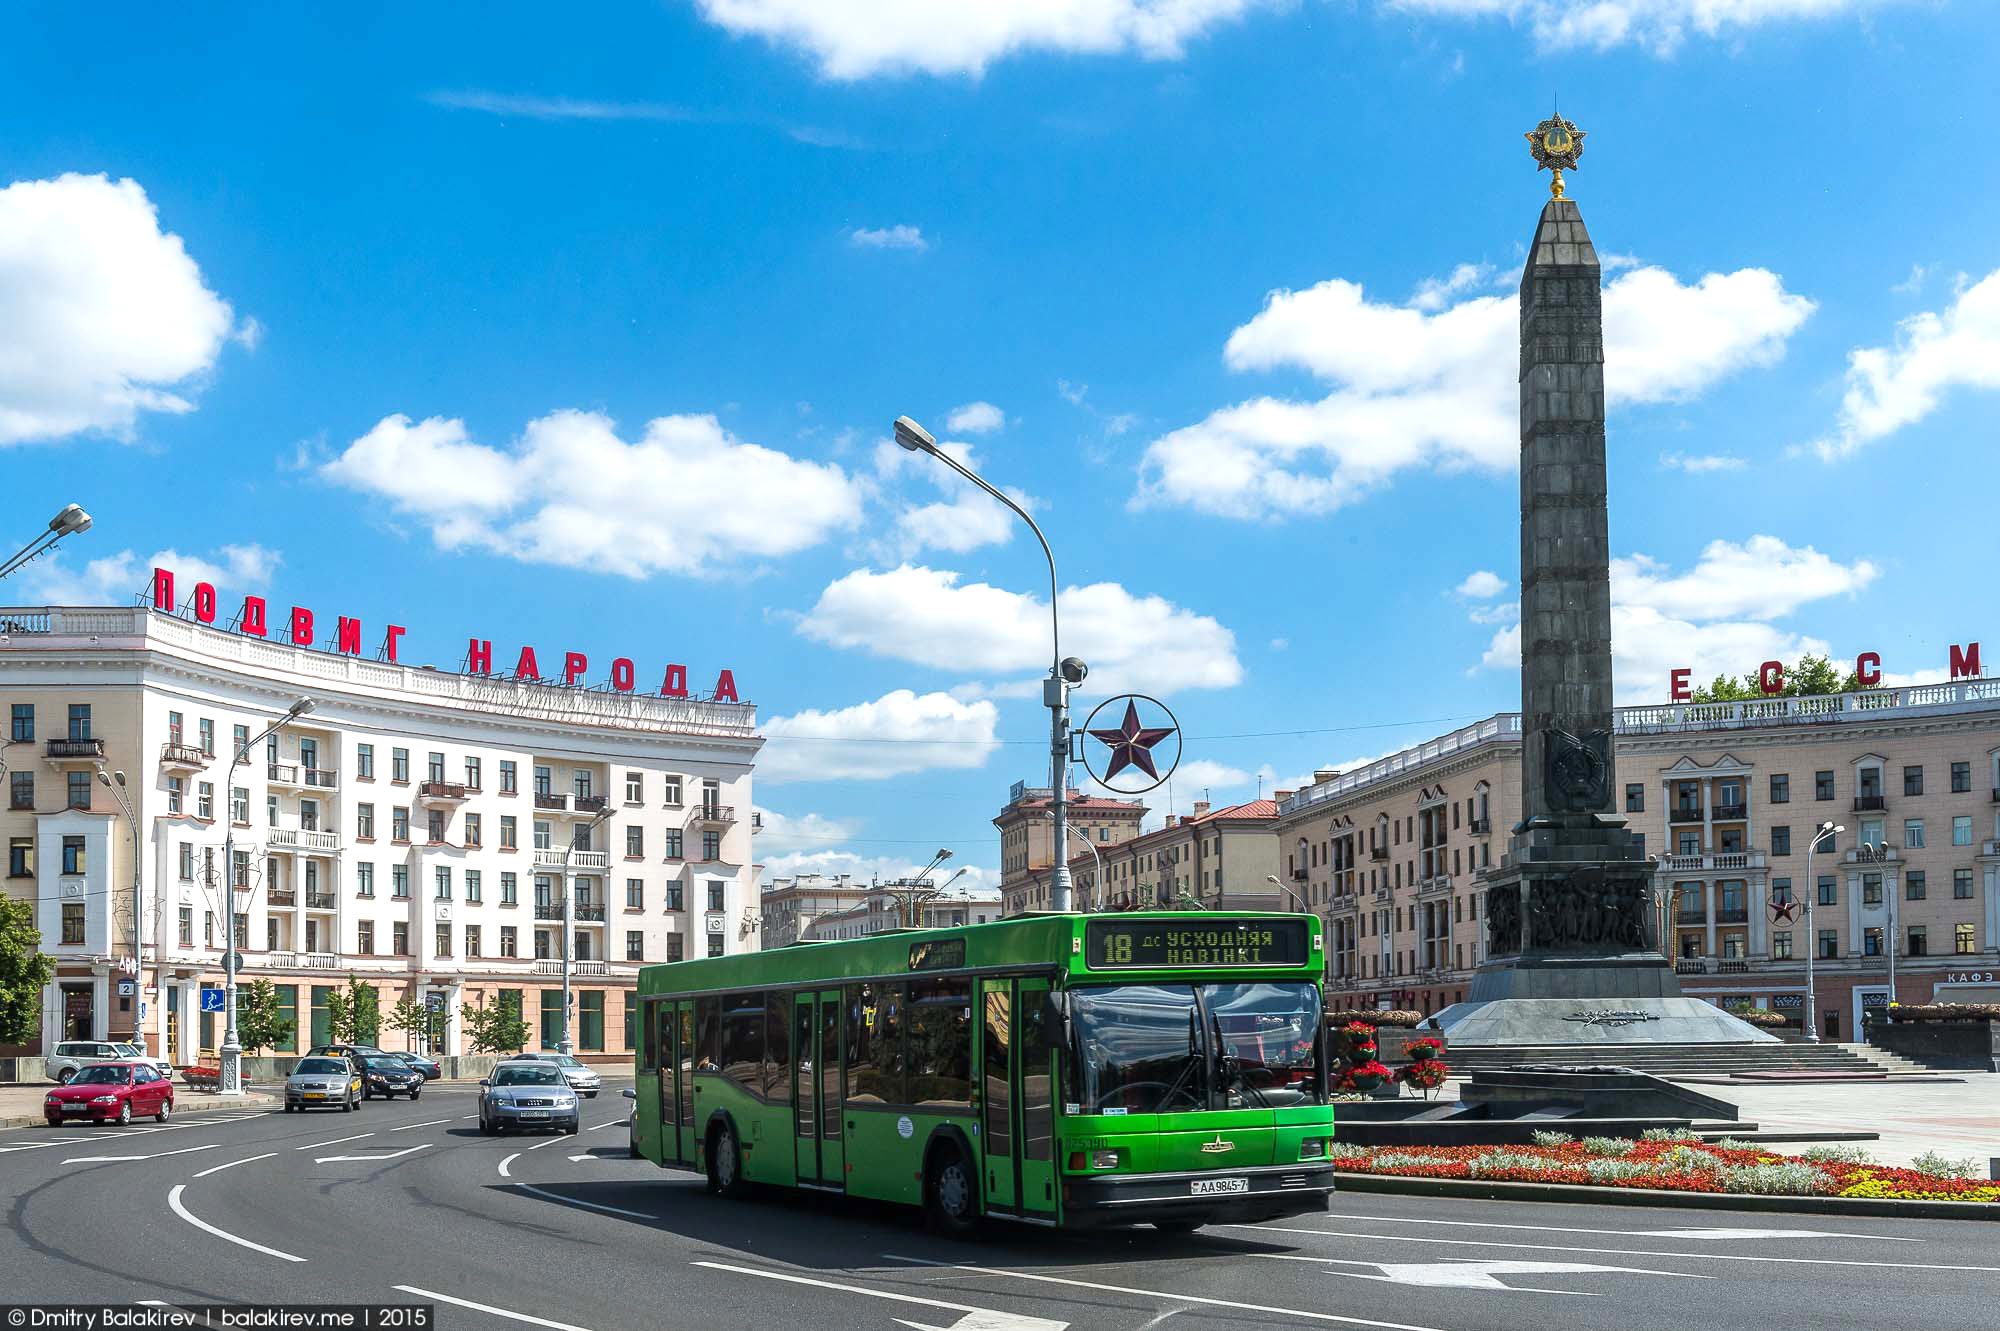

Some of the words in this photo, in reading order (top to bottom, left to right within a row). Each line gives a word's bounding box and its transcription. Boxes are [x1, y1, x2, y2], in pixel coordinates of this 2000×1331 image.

[154, 567, 406, 662] ПОДВИГ
[469, 638, 739, 703] НАРОДА
[1167, 931, 1273, 947] УСХОДНЯЯ
[1103, 934, 1133, 963] 18
[1947, 972, 1993, 983] КАФЭ
[123, 984, 130, 994] 2
